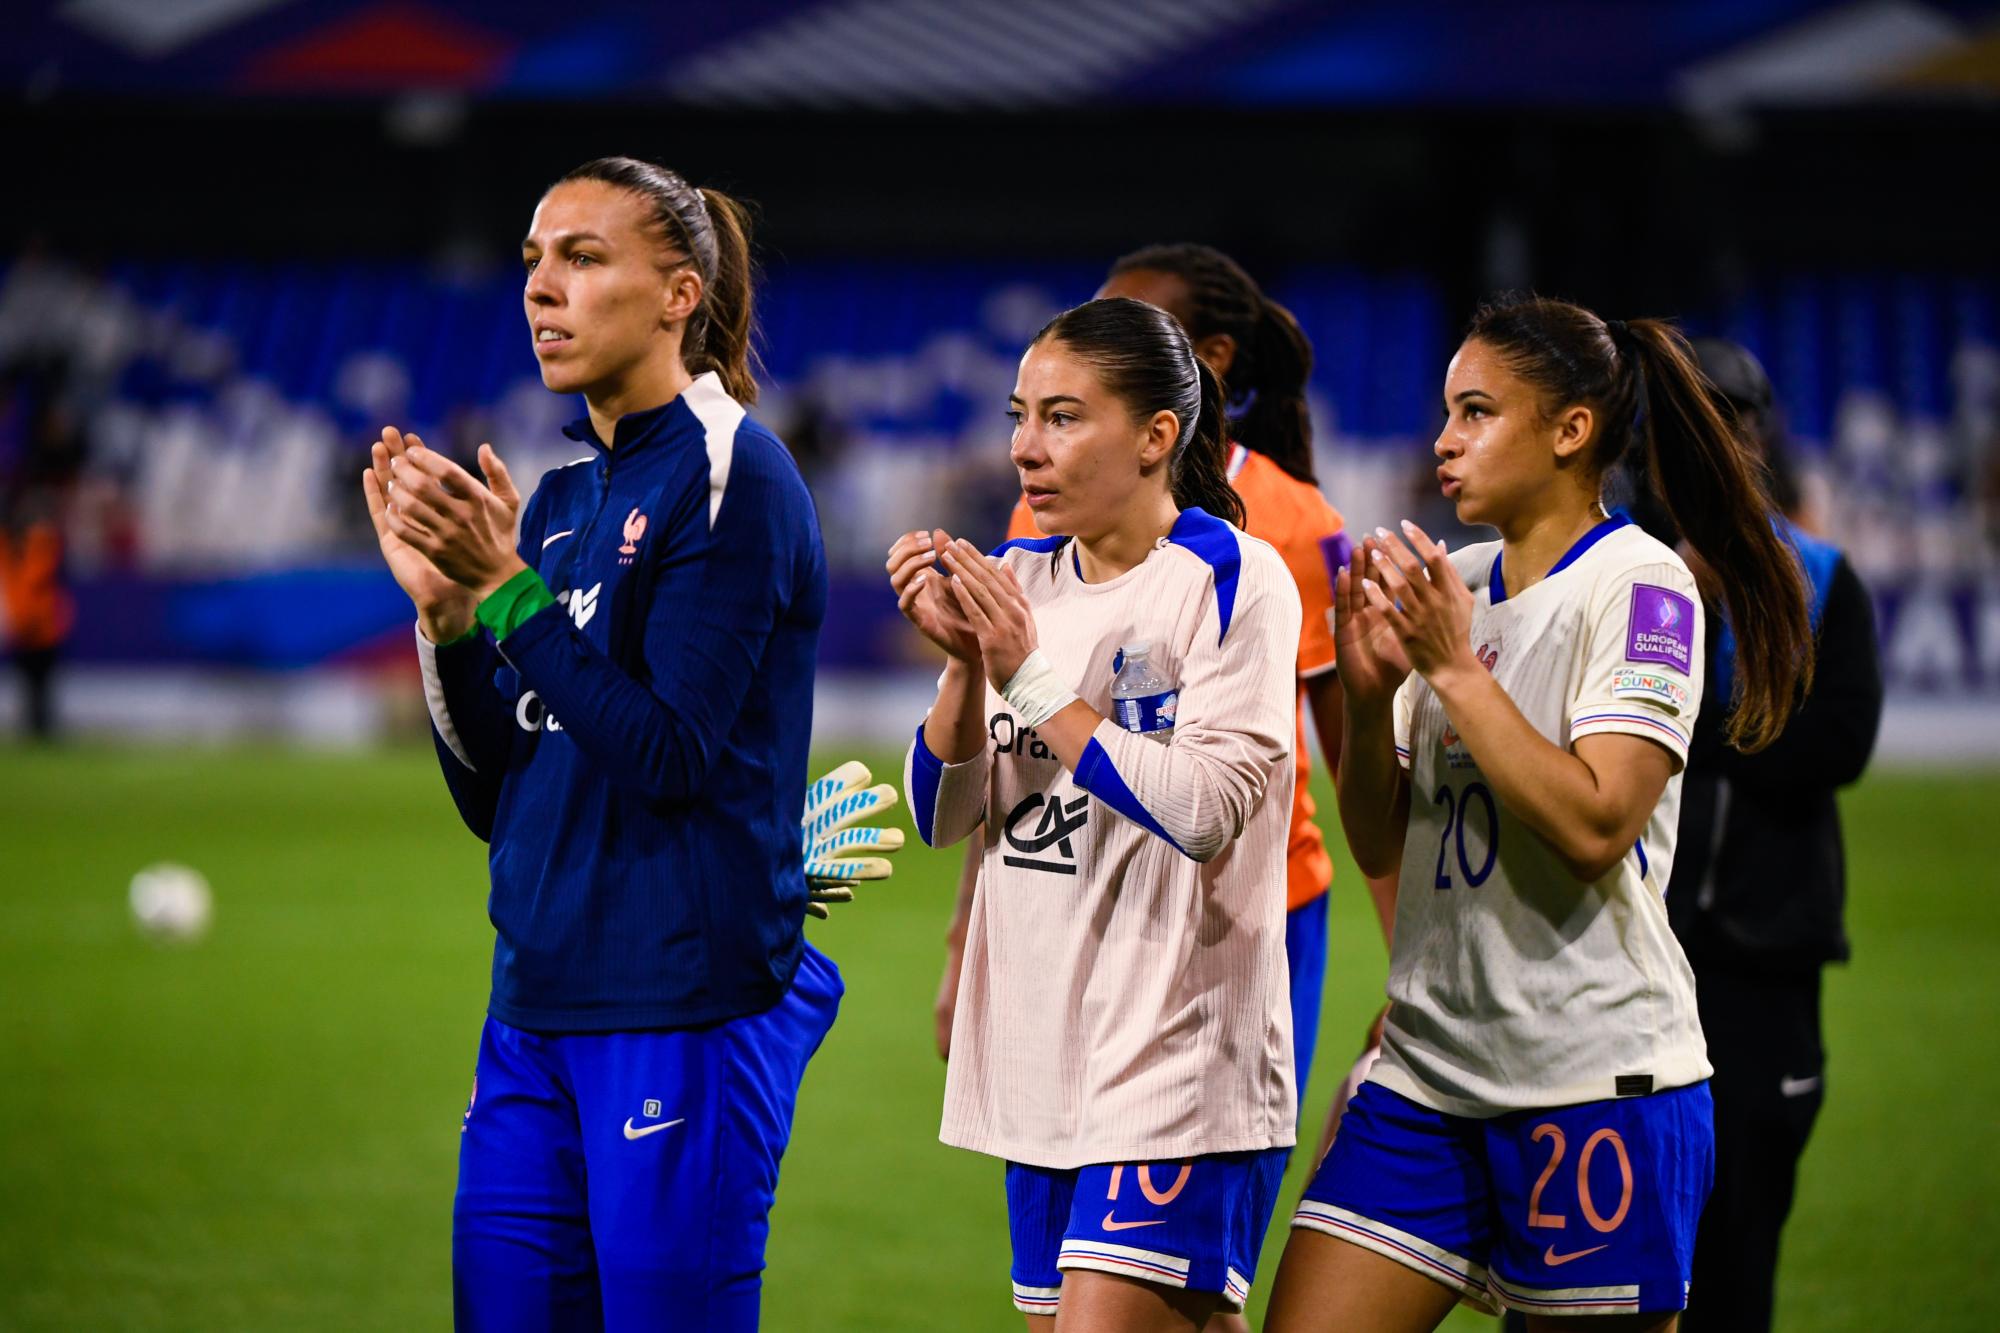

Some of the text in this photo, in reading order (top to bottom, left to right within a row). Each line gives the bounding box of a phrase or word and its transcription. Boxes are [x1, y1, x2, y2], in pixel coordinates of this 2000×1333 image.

[1636, 633, 1687, 654] EUROPEAN
[1613, 677, 1688, 702] FOUNDATIO
[990, 712, 1057, 761] Ora
[1434, 782, 1498, 890] 20
[1528, 1123, 1634, 1233] 20
